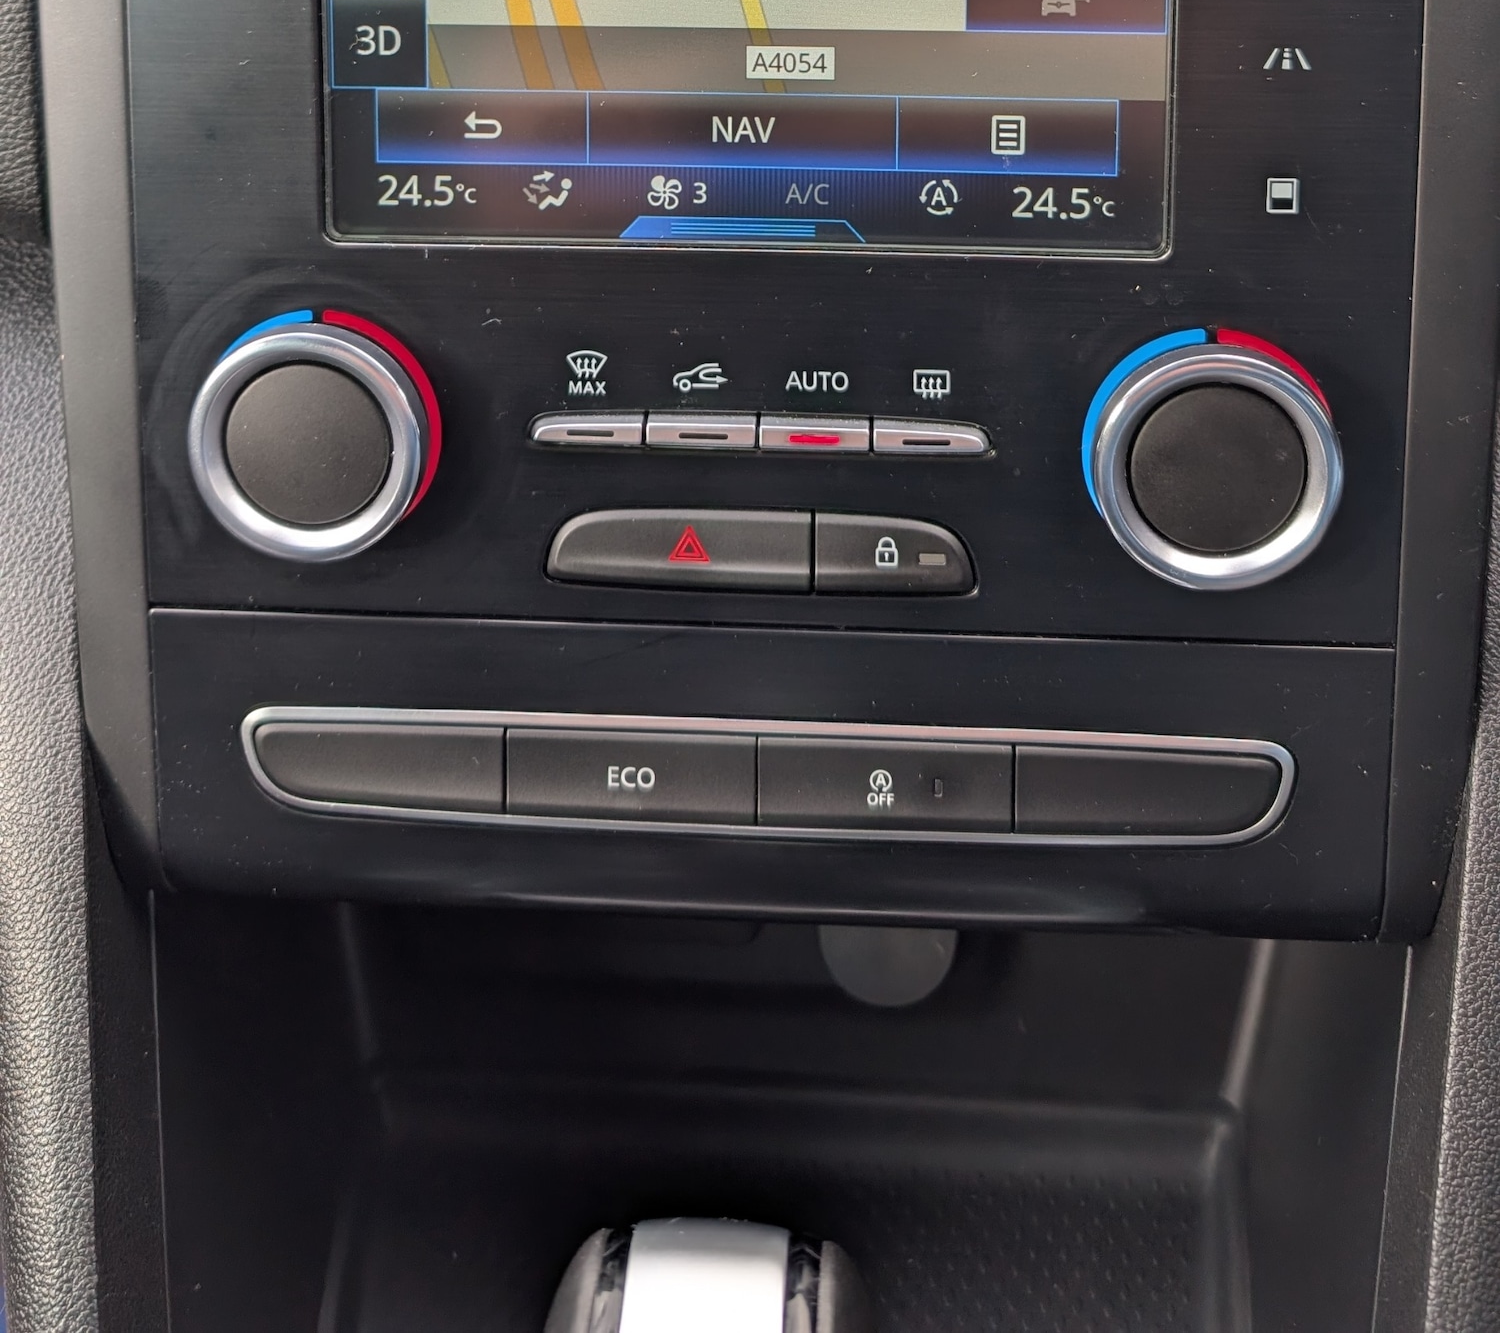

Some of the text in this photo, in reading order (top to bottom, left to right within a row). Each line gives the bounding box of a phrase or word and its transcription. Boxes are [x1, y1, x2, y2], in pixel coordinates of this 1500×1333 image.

[355, 25, 402, 58] 3D
[751, 51, 829, 76] A4054
[710, 116, 776, 145] NAV
[692, 183, 708, 205] 3
[785, 181, 831, 208] A/C
[567, 378, 606, 396] MAX
[785, 369, 849, 393] AUTO
[607, 765, 656, 791] ECO
[866, 792, 896, 806] OFF
